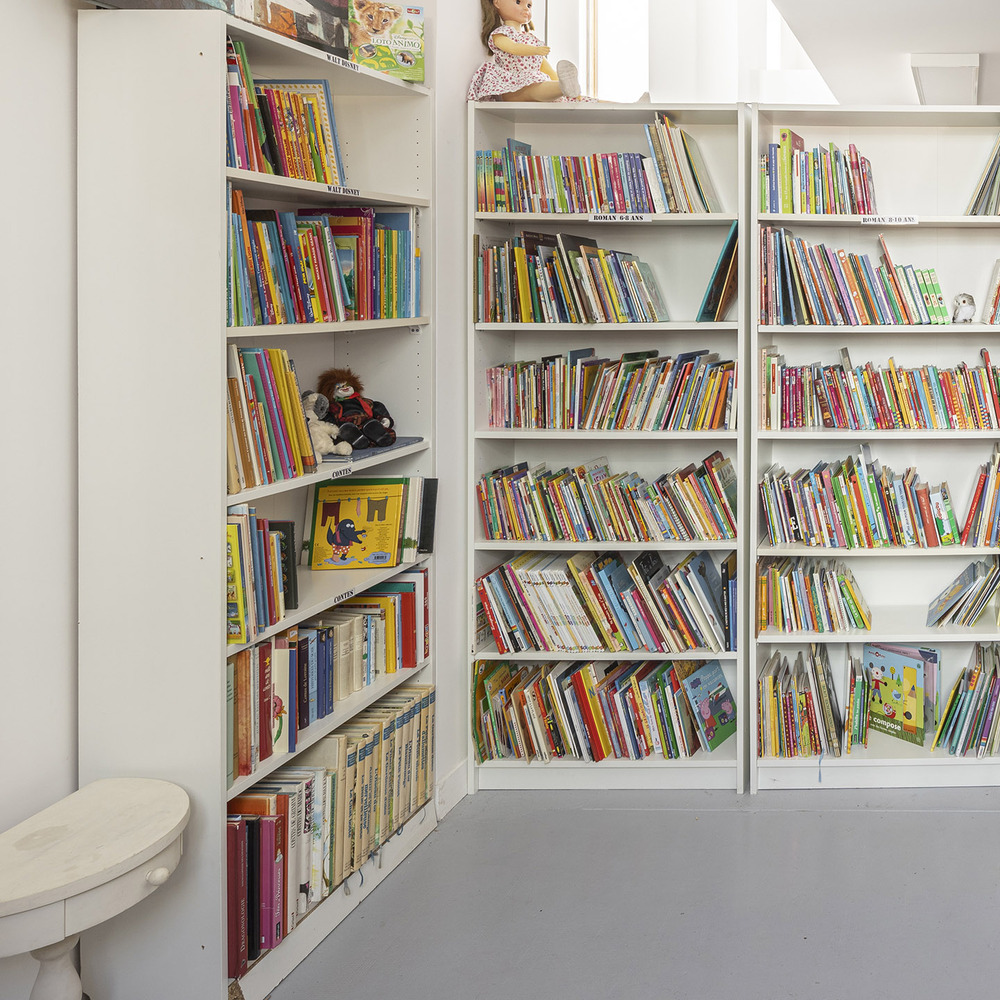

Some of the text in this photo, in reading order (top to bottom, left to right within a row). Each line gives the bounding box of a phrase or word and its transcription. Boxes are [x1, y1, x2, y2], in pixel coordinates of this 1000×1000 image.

[372, 37, 392, 45] LOTO
[393, 39, 420, 48] ANIMO
[326, 54, 359, 71] WALT DISNEY
[327, 185, 360, 196] WALT DISNEY
[332, 467, 352, 478] CONTES
[333, 590, 354, 603] CONTES
[873, 716, 901, 732] compose
